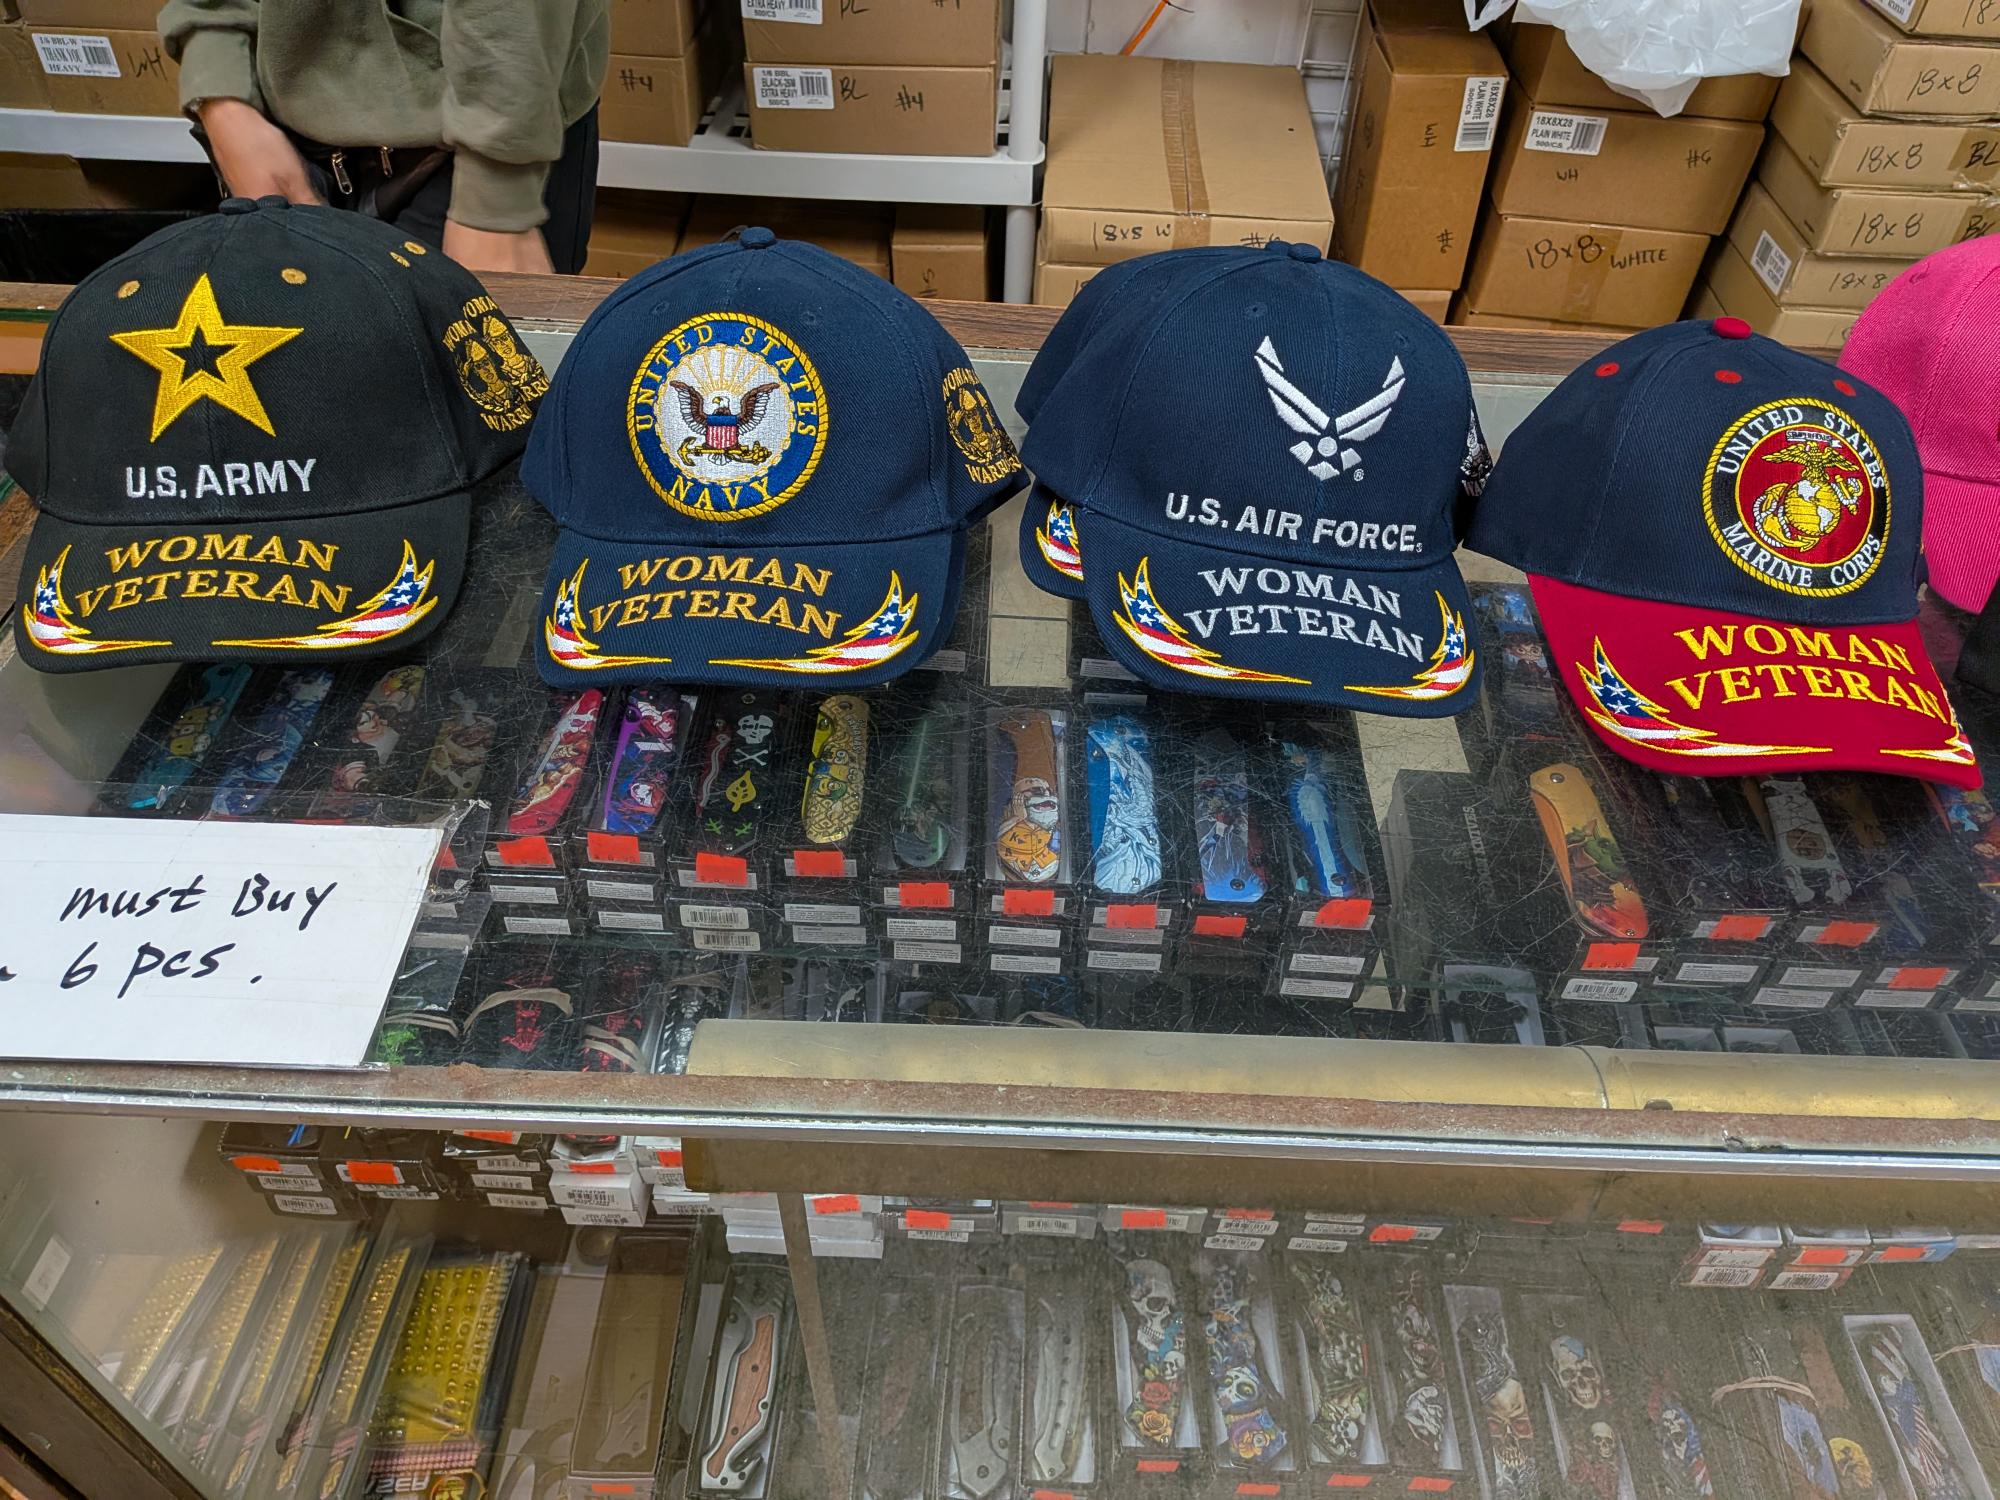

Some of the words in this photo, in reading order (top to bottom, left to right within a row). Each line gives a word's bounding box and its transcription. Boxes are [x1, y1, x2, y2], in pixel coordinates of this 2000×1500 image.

[41, 46, 67, 62] THANK
[66, 48, 83, 63] YOU
[49, 63, 81, 73] HEAVY
[619, 69, 653, 92] #4
[840, 76, 869, 102] BL
[895, 85, 924, 112] #4
[1477, 81, 1488, 102] PLAIN
[1485, 81, 1500, 118] 18X8X28
[1472, 100, 1483, 120] WHITE
[1536, 115, 1574, 128] 18X8X28
[1531, 128, 1550, 139] PLAIN
[1551, 130, 1572, 142] WHITE
[1610, 249, 1668, 270] WHITE
[636, 325, 714, 433] UNITED
[740, 326, 818, 437] STATES
[1716, 406, 1804, 475] UNITED
[1823, 412, 1885, 489] STATES
[125, 465, 187, 500] U.S.
[195, 458, 318, 498] ARMY
[669, 474, 772, 511] NAVY
[1164, 492, 1228, 530] U.S.
[1235, 504, 1303, 541] AIR
[104, 533, 340, 574] WOMAN
[1721, 520, 1814, 588] MARINE
[1830, 534, 1881, 587] CORPS
[74, 569, 353, 619] VETERAN
[617, 555, 834, 597] WOMAN
[1197, 567, 1402, 620] WOMAN
[589, 590, 842, 639] VETERAN
[1183, 604, 1425, 663] VETERAN
[1673, 624, 1917, 676] WOMAN
[1664, 664, 1948, 725] VETERAN
[59, 874, 207, 923] must
[231, 872, 338, 932] Buy
[60, 941, 98, 990] 6
